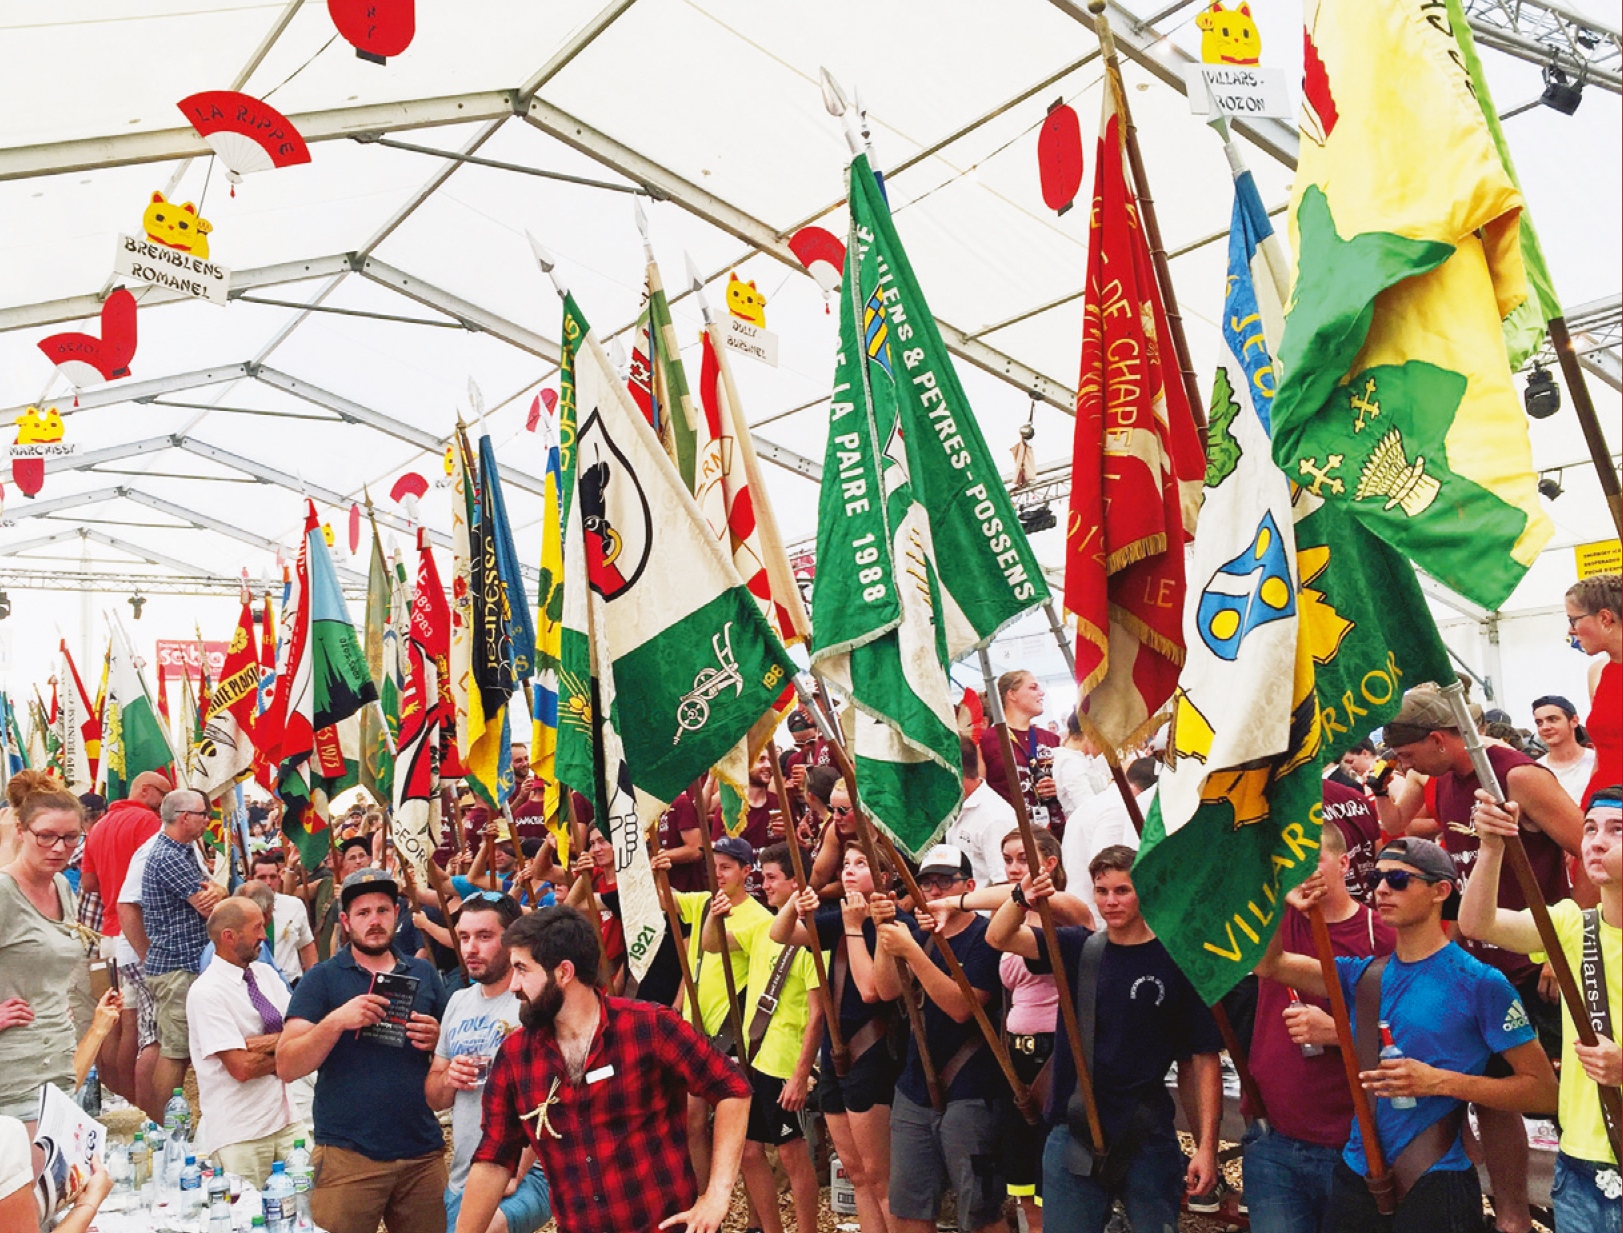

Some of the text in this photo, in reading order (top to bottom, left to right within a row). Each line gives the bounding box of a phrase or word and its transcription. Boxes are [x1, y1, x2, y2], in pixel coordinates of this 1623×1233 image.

[195, 104, 295, 156] LA RIPPE
[124, 236, 225, 280] BREMBLENS
[131, 262, 211, 299] ROMANEL
[902, 347, 925, 371] &
[834, 431, 871, 517] PAIRE
[912, 370, 1035, 602] PEYRES-POSSENS
[852, 533, 887, 603] 1988
[629, 925, 656, 960] 1921
